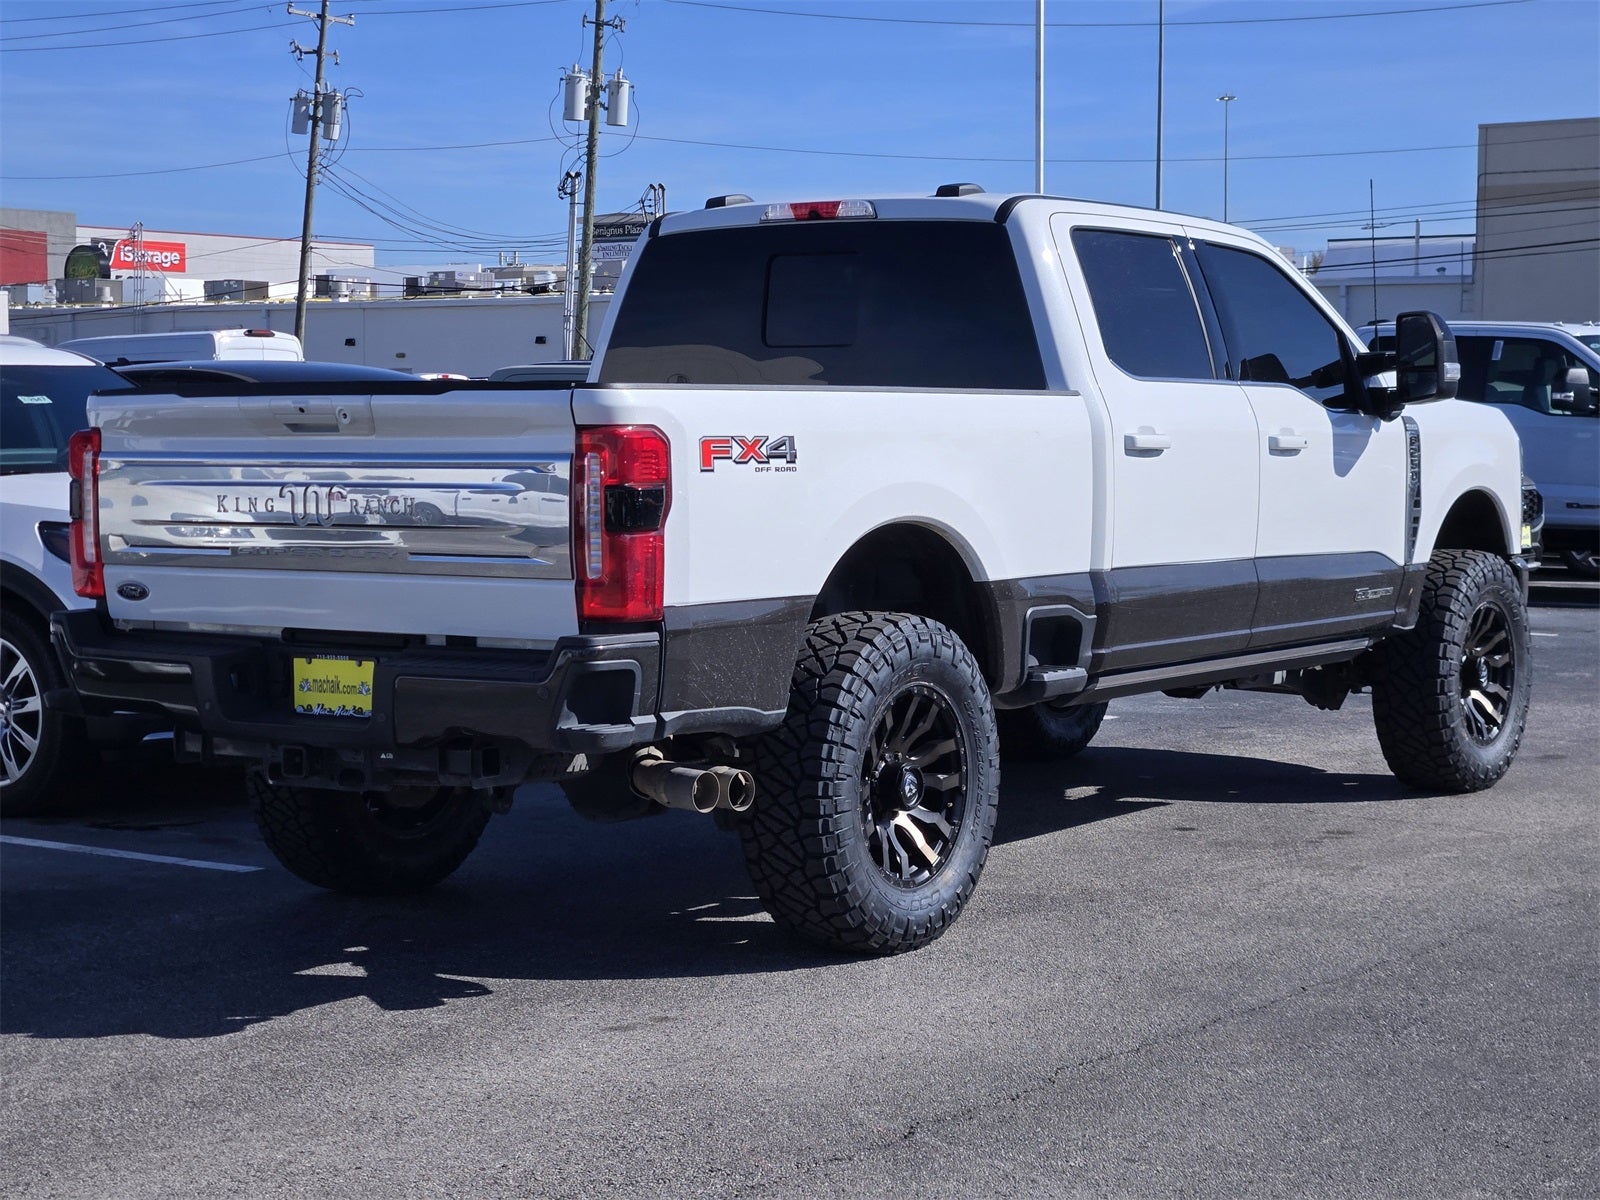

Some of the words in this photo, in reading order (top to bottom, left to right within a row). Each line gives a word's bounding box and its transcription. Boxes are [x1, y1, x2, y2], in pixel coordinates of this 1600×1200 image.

[120, 246, 180, 267] iStorage
[699, 435, 797, 473] FX4
[216, 494, 275, 513] KING
[349, 496, 416, 515] RANCH
[312, 675, 357, 694] machaik.com
